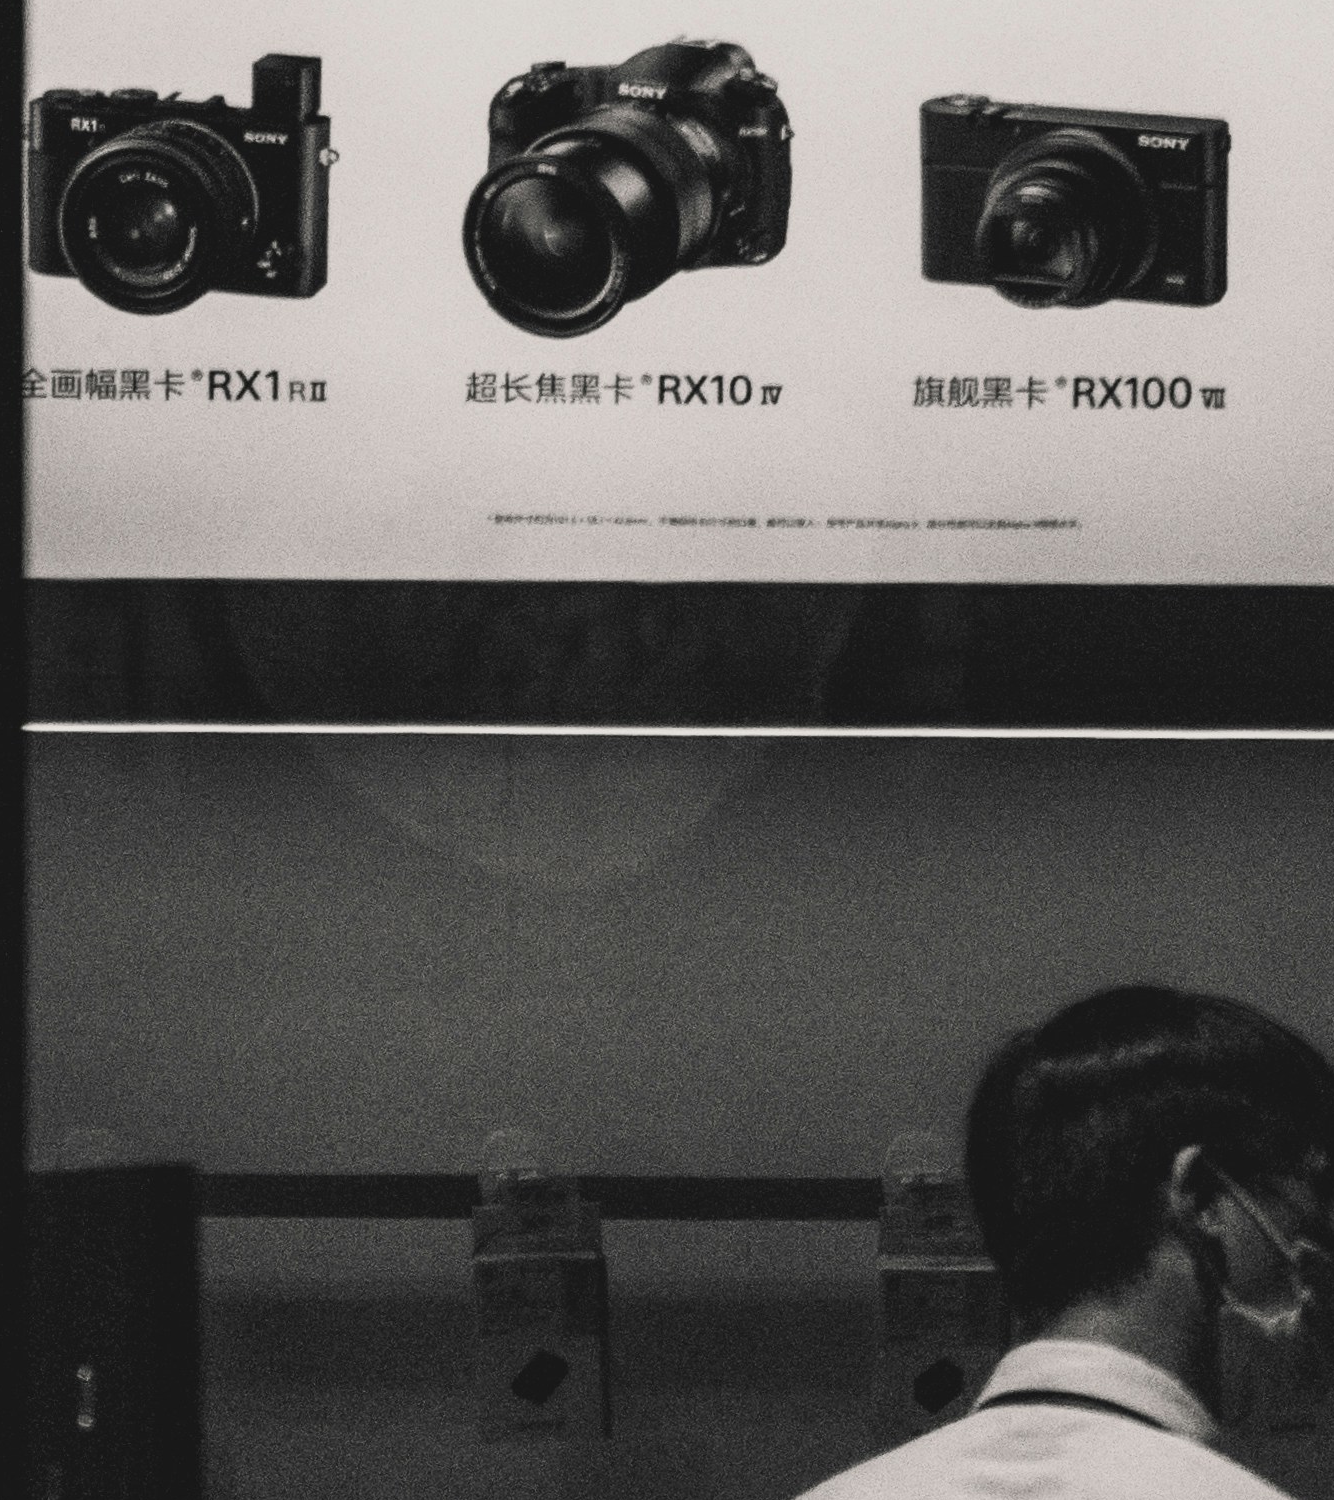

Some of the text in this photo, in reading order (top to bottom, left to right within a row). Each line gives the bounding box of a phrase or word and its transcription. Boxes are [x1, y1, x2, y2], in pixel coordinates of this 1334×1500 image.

[617, 82, 667, 100] SONY
[243, 131, 288, 145] SONY
[1137, 134, 1190, 151] SONY
